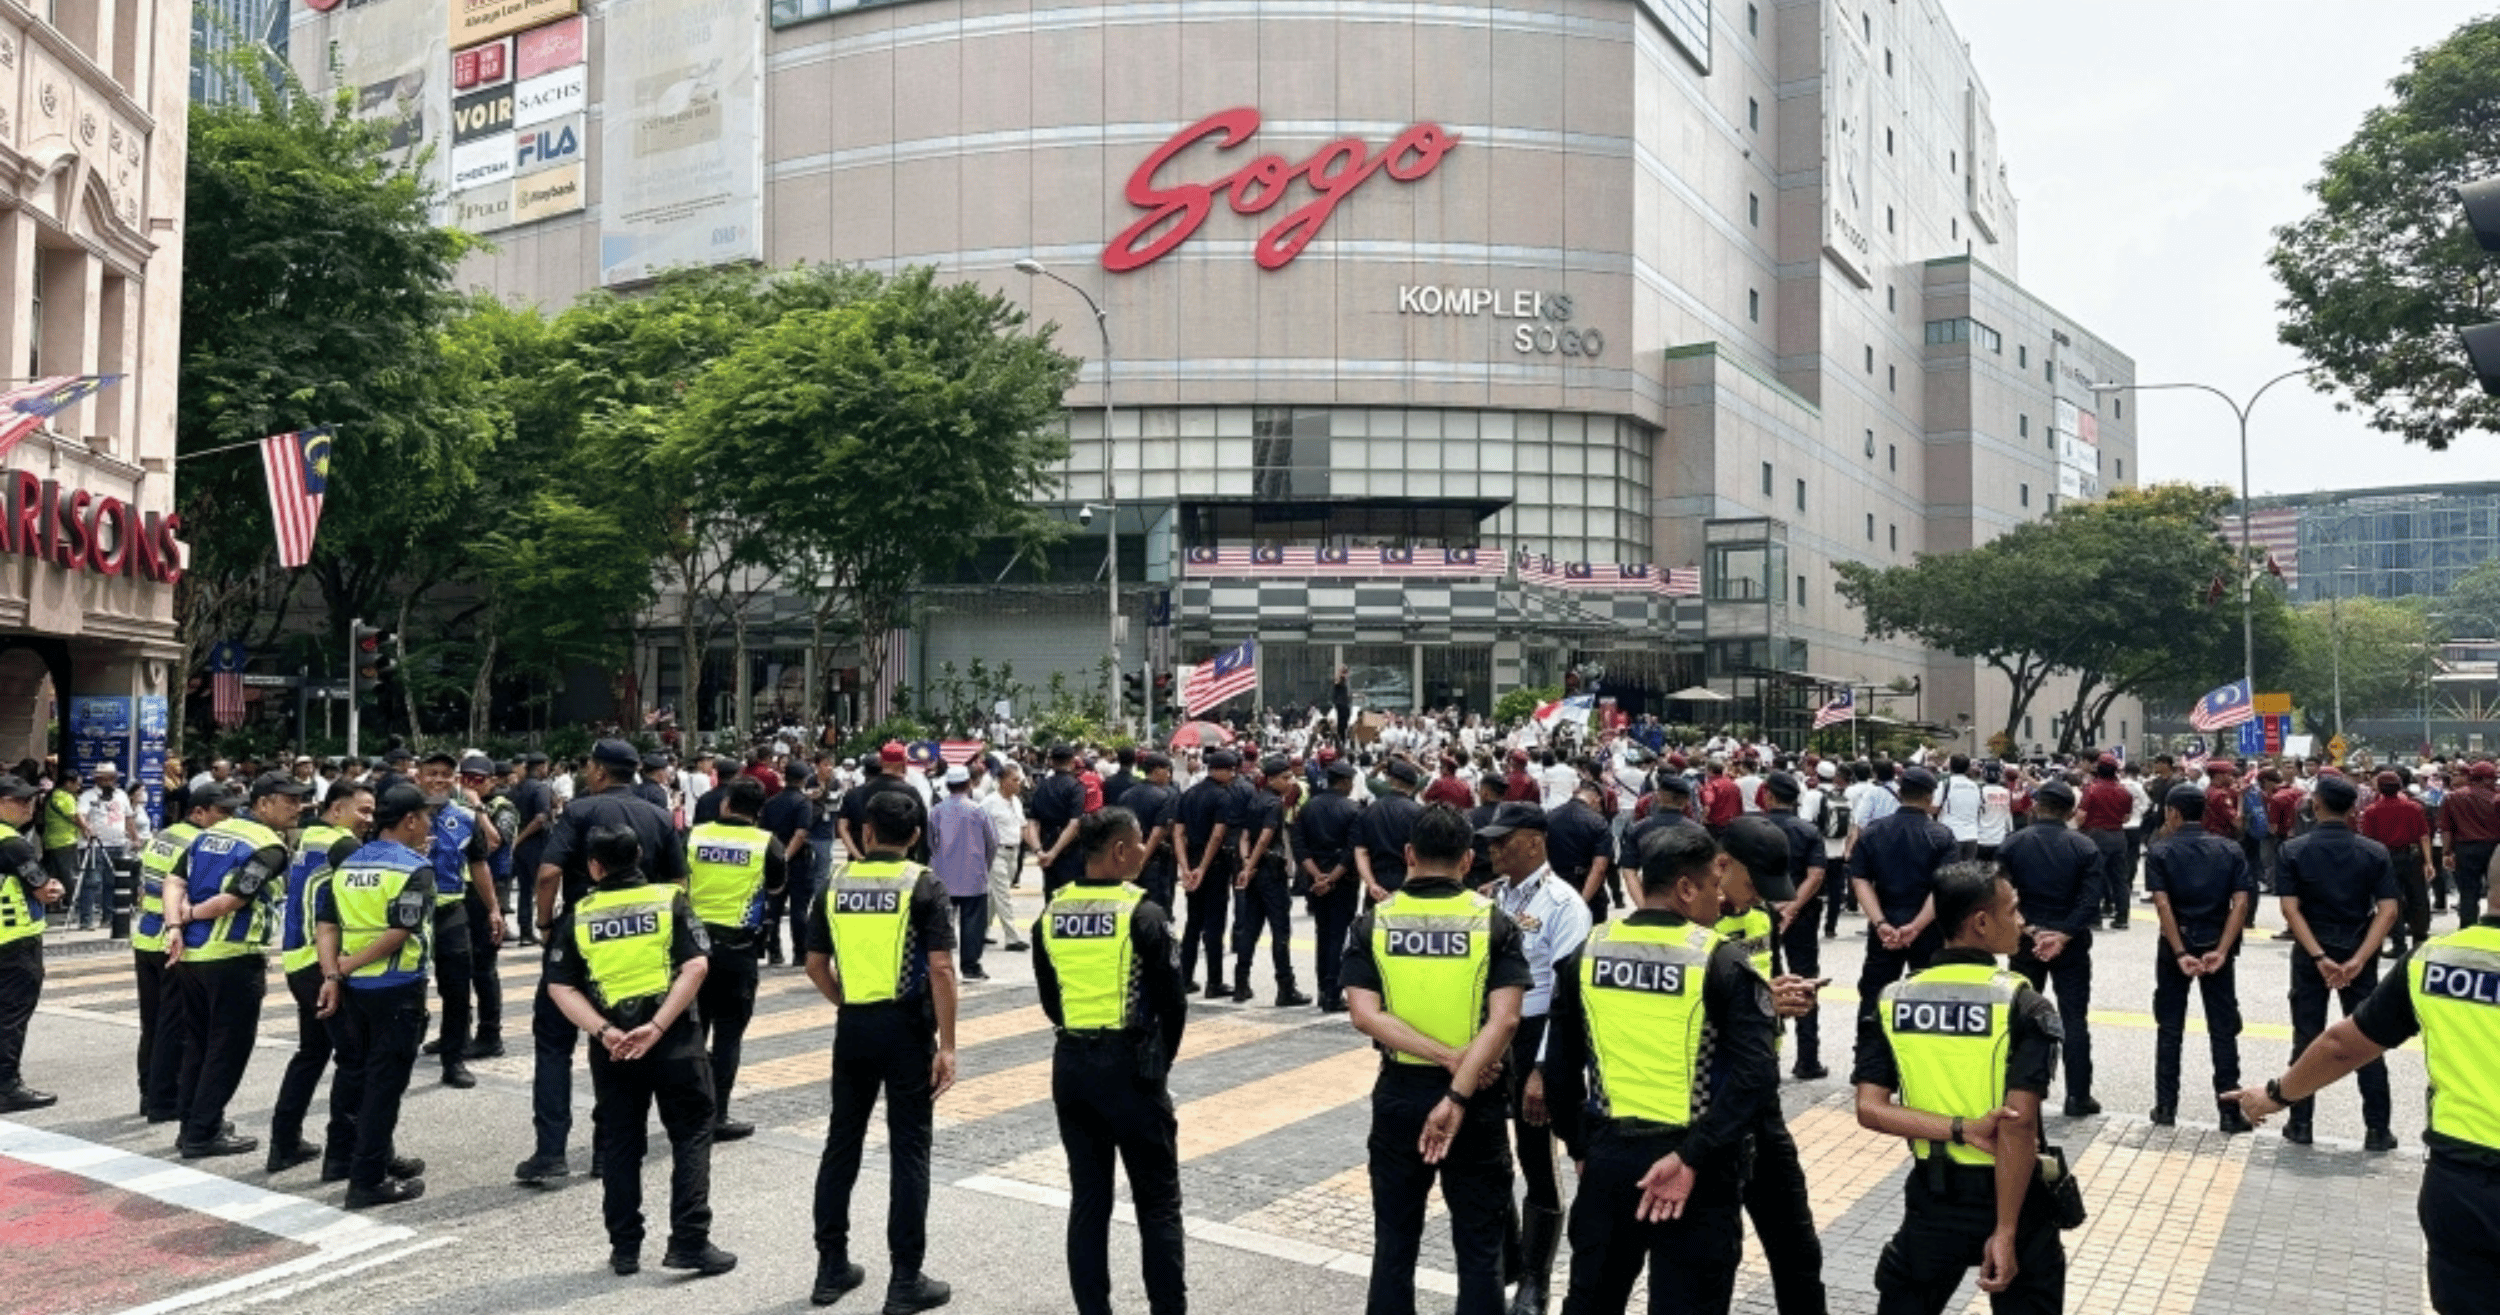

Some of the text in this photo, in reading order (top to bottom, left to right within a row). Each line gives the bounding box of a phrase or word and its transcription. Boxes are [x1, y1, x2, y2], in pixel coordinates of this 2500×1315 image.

[518, 81, 582, 112] SACHS
[455, 96, 513, 135] VOIR
[517, 125, 578, 168] FILA
[1100, 105, 1463, 275] Sogo
[1398, 285, 1574, 322] KOMPLEKS
[1513, 323, 1604, 357] SOGO
[0, 468, 183, 585] RISONS
[699, 848, 749, 864] POLIS
[836, 892, 897, 912] POLIS
[591, 915, 657, 941] POLIS
[1053, 913, 1114, 936] POLIS
[1387, 931, 1469, 956] POLIS
[1595, 960, 1681, 992] POLIS
[1894, 1003, 1987, 1032] POLIS
